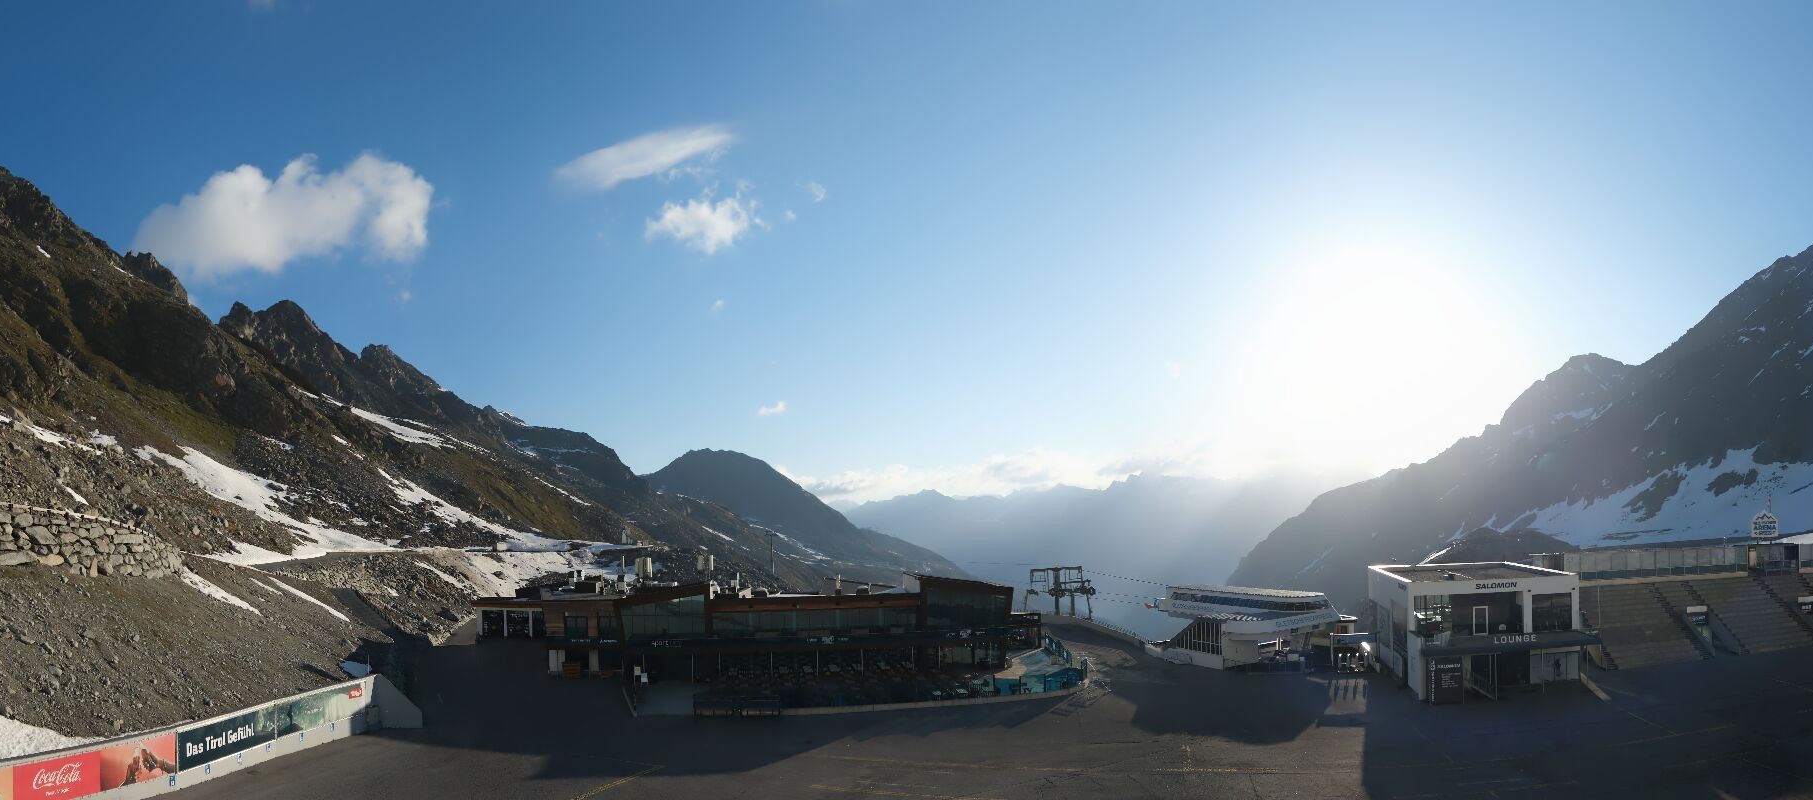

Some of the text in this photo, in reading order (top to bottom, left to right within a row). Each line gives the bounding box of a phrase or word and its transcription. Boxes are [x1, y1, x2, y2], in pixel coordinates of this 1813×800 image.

[1475, 582, 1517, 590] SALOMON
[1494, 634, 1537, 644] LOUNGE
[186, 723, 254, 757] Das Tirol Gefühl
[33, 762, 82, 789] Coca-Cola
